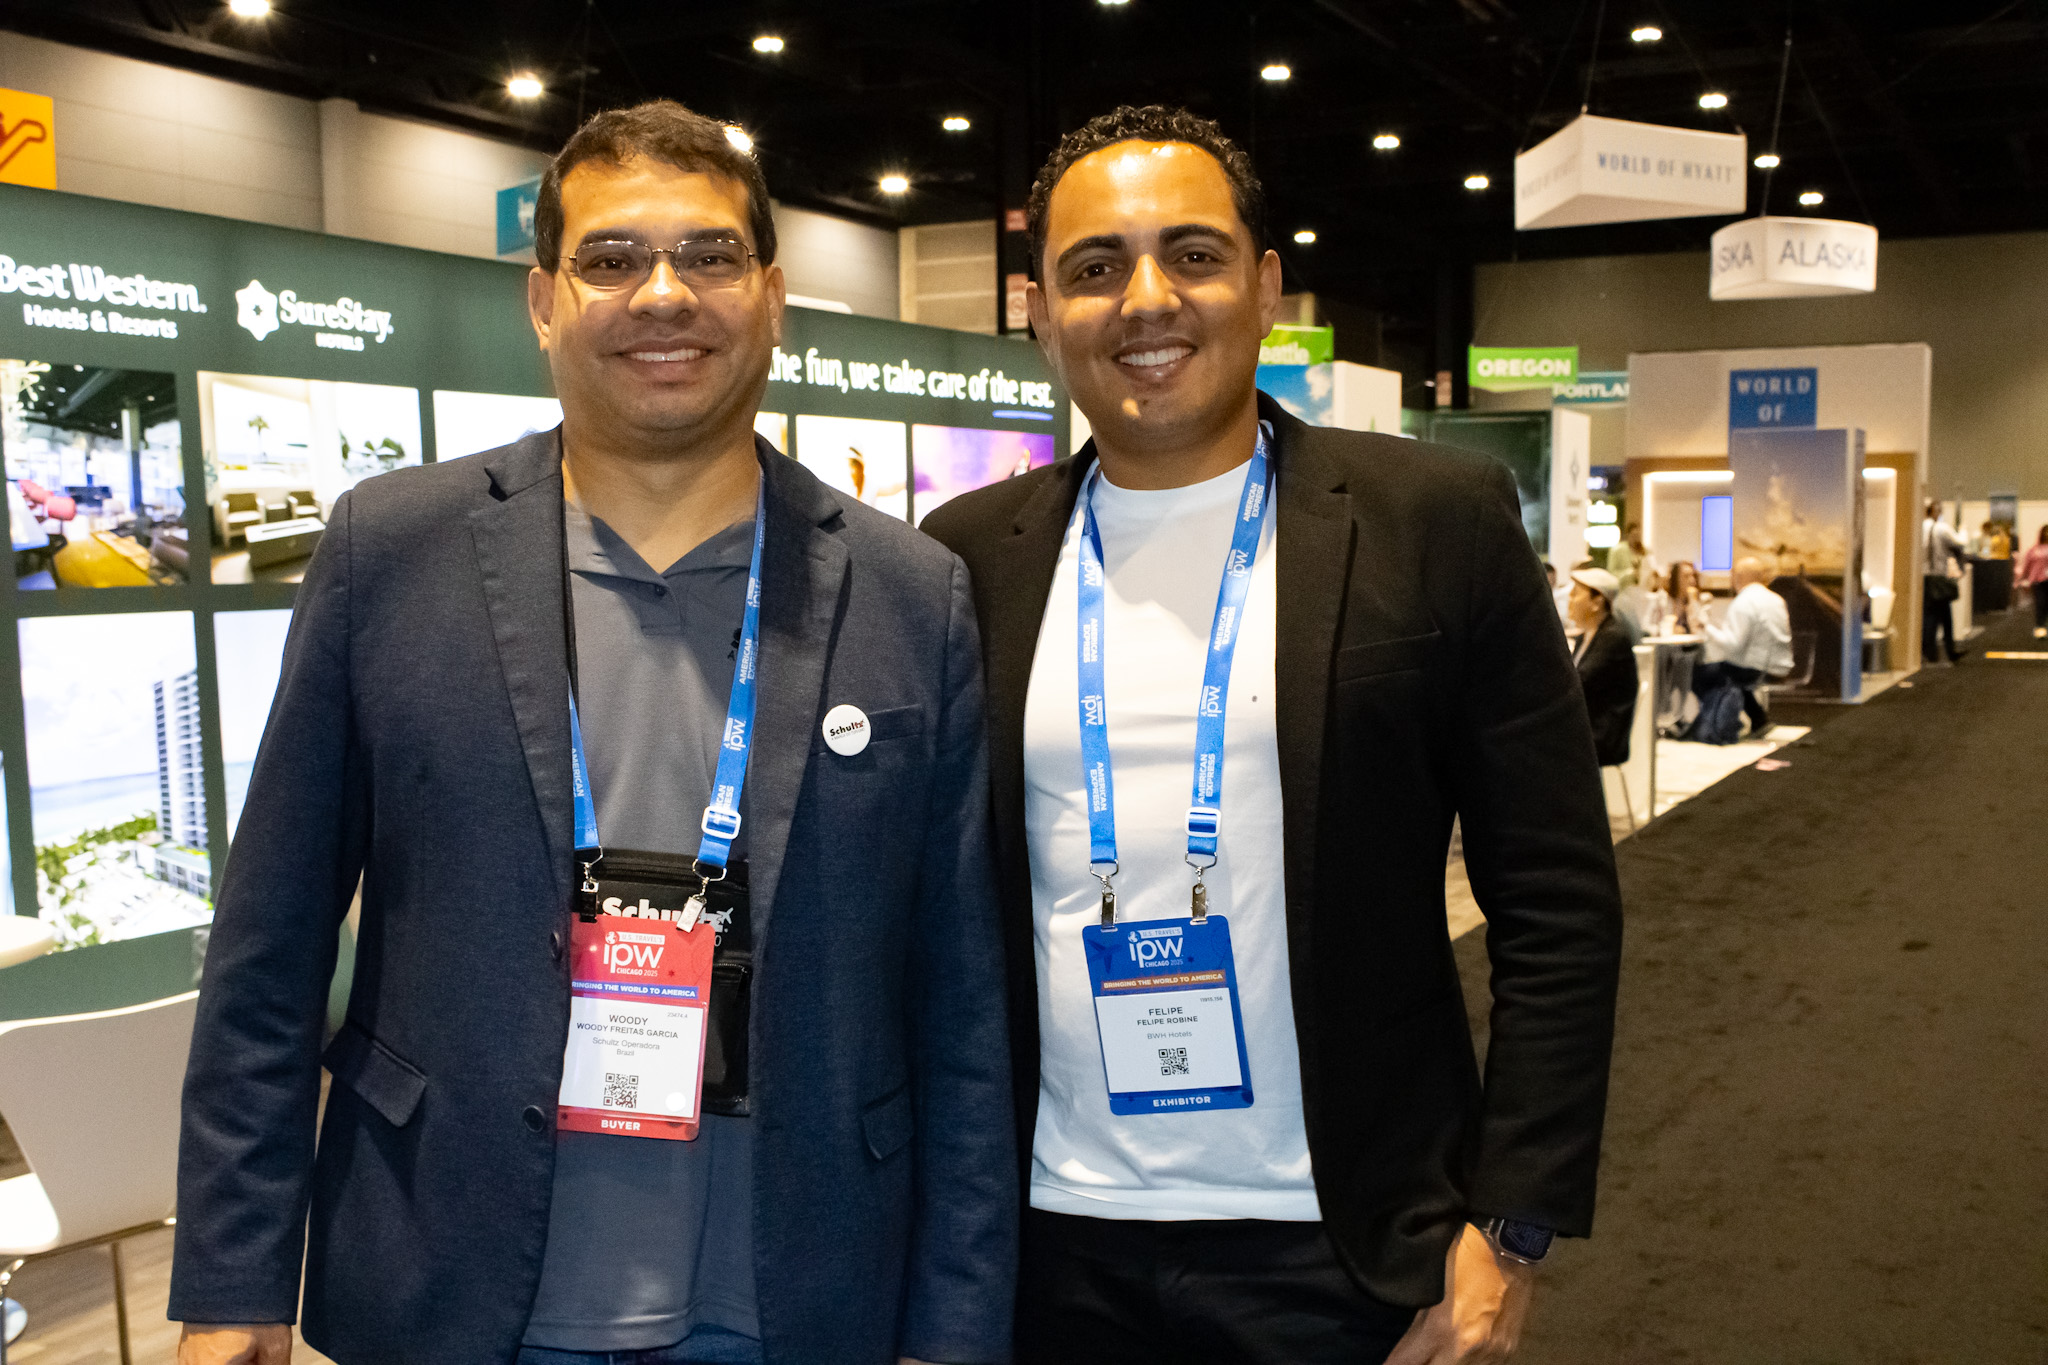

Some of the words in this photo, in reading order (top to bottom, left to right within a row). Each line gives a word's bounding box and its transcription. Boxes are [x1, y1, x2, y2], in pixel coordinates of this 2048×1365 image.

[1597, 151, 1651, 174] WORLD
[1657, 159, 1675, 177] OF
[1718, 241, 1754, 273] SKA
[1779, 238, 1869, 271] ALASKA
[0, 254, 71, 300] Best
[23, 303, 89, 331] Hotels
[90, 310, 108, 333] &
[108, 311, 179, 339] Resorts
[805, 347, 849, 393] fun,
[848, 361, 880, 391] we
[882, 359, 925, 396] take
[927, 370, 966, 400] care
[967, 368, 990, 401] of
[989, 370, 1019, 405] the
[1020, 381, 1055, 408] rest.
[1477, 358, 1572, 377] OREGON
[1552, 382, 1630, 399] PORTLA
[1736, 376, 1811, 395] WORLD
[1757, 404, 1784, 422] OF
[1243, 482, 1258, 522] AMERICAN
[1251, 484, 1265, 518] EXPRESS
[1232, 549, 1249, 578] ipw
[1213, 606, 1229, 652] AMERICAN
[739, 638, 753, 685] AMERICAN
[1081, 695, 1098, 726] ipw
[1205, 686, 1223, 718] ipw
[730, 718, 747, 752] ipw
[829, 720, 865, 737] Schultz
[572, 748, 584, 797] AMERICAN
[1096, 761, 1107, 811] AMERICAN
[1198, 754, 1208, 804] AMERICAN
[1206, 753, 1216, 798] EXPRESS
[1090, 769, 1101, 812] EXPRESS
[603, 943, 664, 974] ipw
[1128, 937, 1184, 968] ipw
[1144, 960, 1170, 968] CHICAGO
[616, 967, 643, 976] CHICAGO
[643, 969, 658, 977] 2025
[1103, 981, 1137, 989] BRINGING
[1191, 973, 1223, 981] AMERICA
[572, 981, 603, 990] RINGING
[620, 985, 648, 994] WORLD
[661, 988, 696, 998] AMERICA
[608, 1014, 649, 1026] WOODY
[1136, 1018, 1165, 1026] FELIPE
[1166, 1015, 1199, 1024] ROBINE
[1148, 1006, 1184, 1016] FELIPE
[576, 1022, 608, 1032] WOODY
[610, 1025, 644, 1036] FREITAS
[646, 1029, 679, 1039] GARCIA
[592, 1036, 619, 1046] Schultz
[621, 1039, 660, 1050] Operadora
[616, 1048, 635, 1056] Brazil
[1152, 1096, 1211, 1107] EXHIBITOR
[601, 1119, 641, 1131] BUYER
